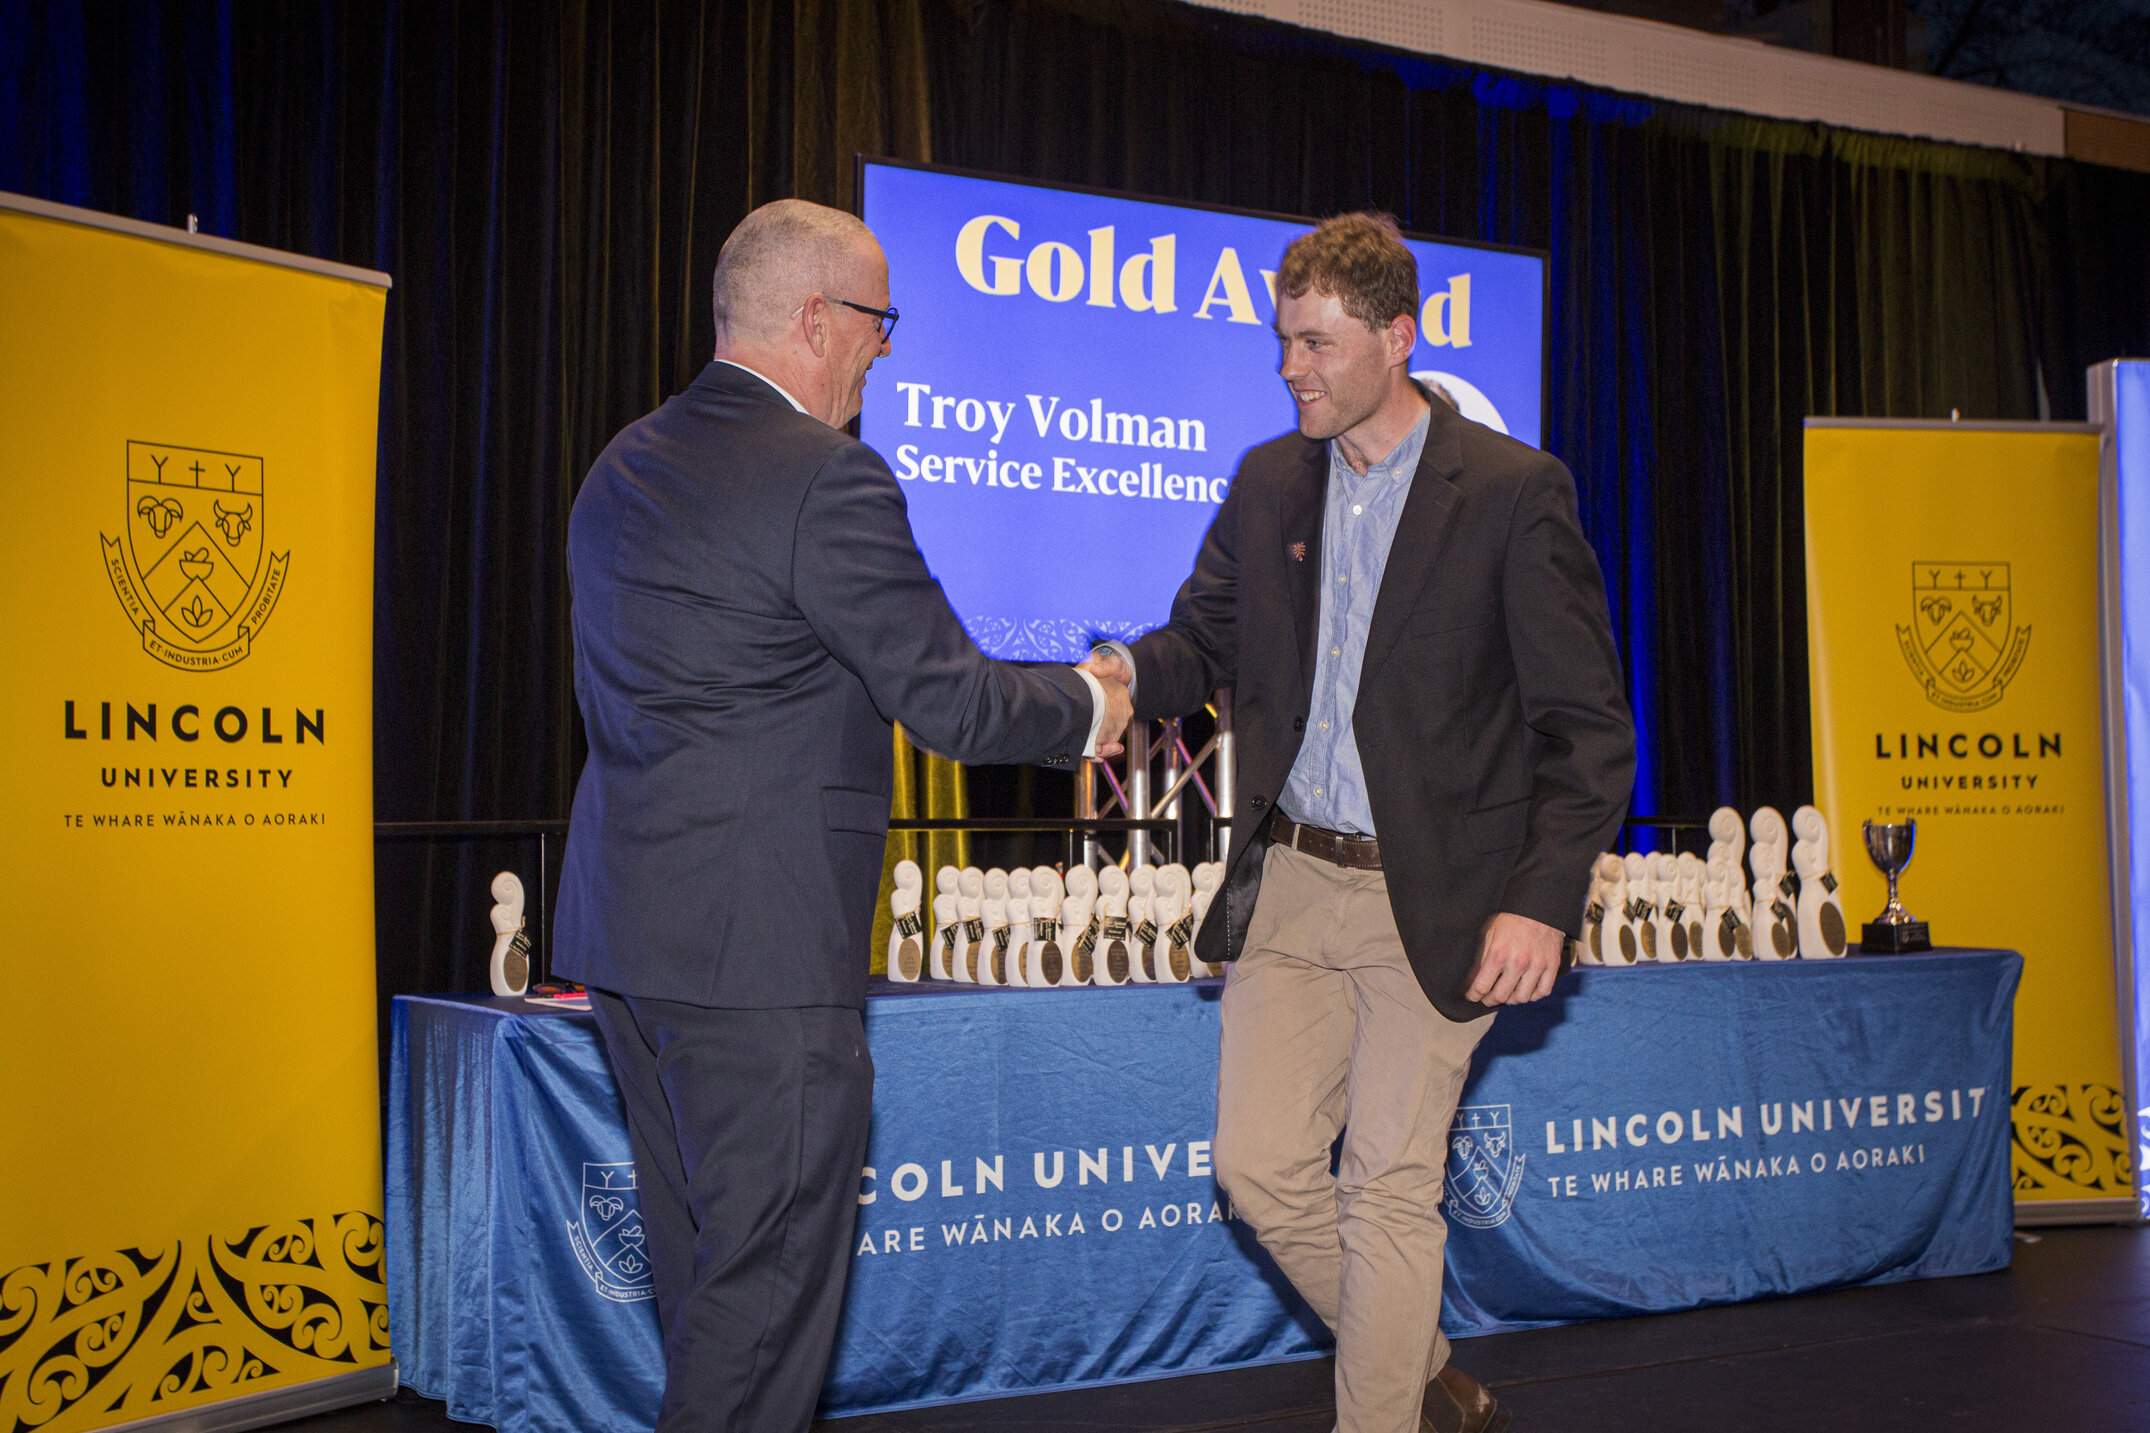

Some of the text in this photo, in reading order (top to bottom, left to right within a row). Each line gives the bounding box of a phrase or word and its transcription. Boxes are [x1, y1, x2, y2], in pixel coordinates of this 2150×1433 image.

[955, 215, 1178, 314] Gold
[896, 381, 1207, 452] Troy Volman
[895, 444, 1228, 504] Service Excellenc
[111, 559, 139, 616] SCIENTIA
[251, 568, 281, 625] PROBITATE
[65, 700, 325, 745] LINCOLN
[1876, 733, 2062, 759] LINCOLN
[101, 767, 293, 788] UNIVERSITY
[1902, 775, 2038, 790] UNIVERSITY
[64, 811, 325, 827] TE WHARE WĀNAKA O AORAKI
[1878, 806, 1891, 816] TE
[1546, 1085, 1988, 1154] LINCOLN UNIVERSIT
[1034, 1141, 1212, 1189] UNIVE
[1548, 1175, 1578, 1198] TE
[1592, 1165, 1682, 1193] WHARE
[1694, 1155, 1800, 1183] WĀNAKA
[1811, 1152, 1827, 1173] O
[1836, 1144, 1925, 1171] AORAKI
[857, 1200, 1240, 1256] ARE WĀNAKA O AORAK
